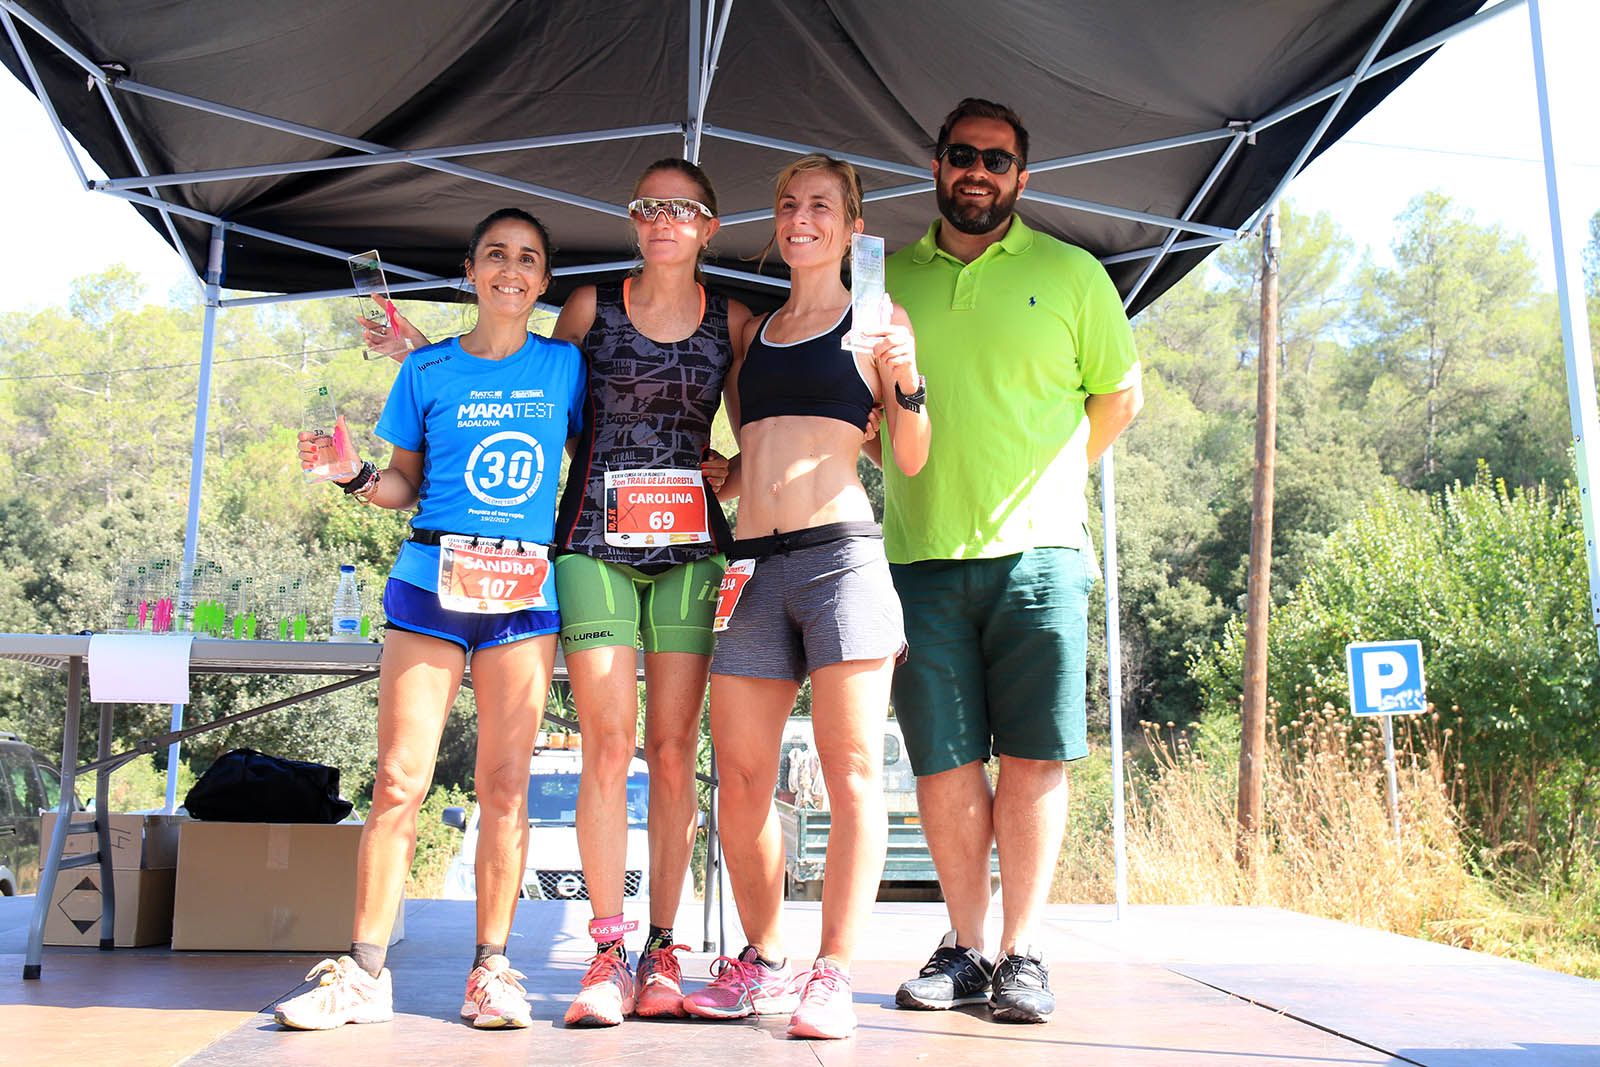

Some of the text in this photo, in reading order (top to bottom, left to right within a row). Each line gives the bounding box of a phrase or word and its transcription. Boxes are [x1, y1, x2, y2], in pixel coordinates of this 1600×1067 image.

[457, 402, 555, 419] MARATEST
[457, 420, 500, 428] BADALONA
[479, 450, 534, 490] 30
[627, 477, 646, 485] TRAIL
[647, 477, 657, 485] DE
[657, 477, 666, 485] LA
[666, 476, 694, 485] FLORESTA
[628, 492, 694, 504] CAROLINA
[649, 511, 675, 530] 69
[463, 556, 535, 575] SANDRA
[478, 576, 518, 599] 107
[573, 631, 614, 641] LURBEL
[1362, 650, 1409, 708] P
